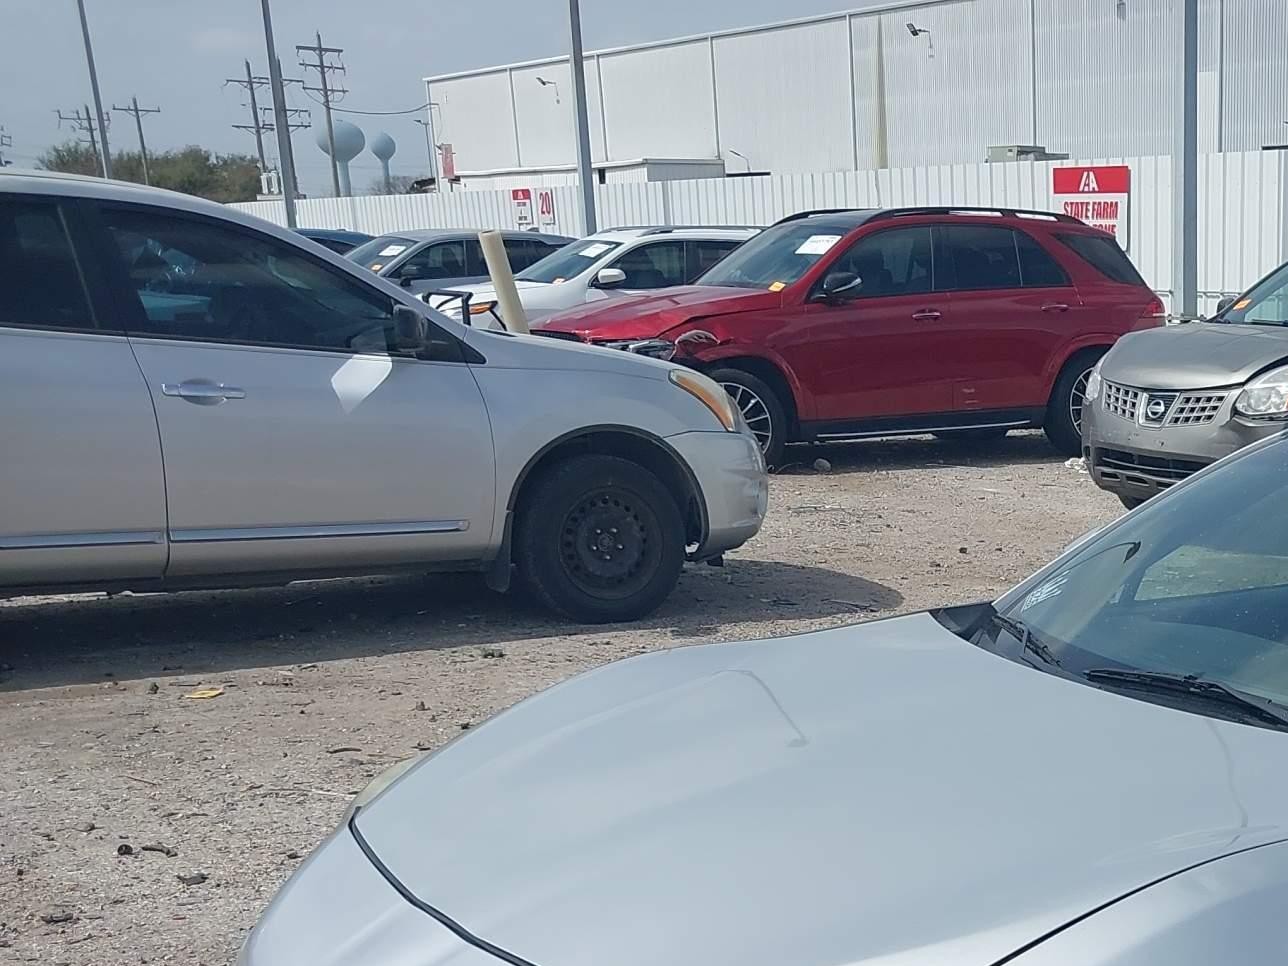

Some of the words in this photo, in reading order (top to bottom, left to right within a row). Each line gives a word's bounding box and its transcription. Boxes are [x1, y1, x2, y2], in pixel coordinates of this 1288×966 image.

[540, 192, 551, 214] 20
[1064, 202, 1090, 219] STATE
[1092, 202, 1118, 219] FARM
